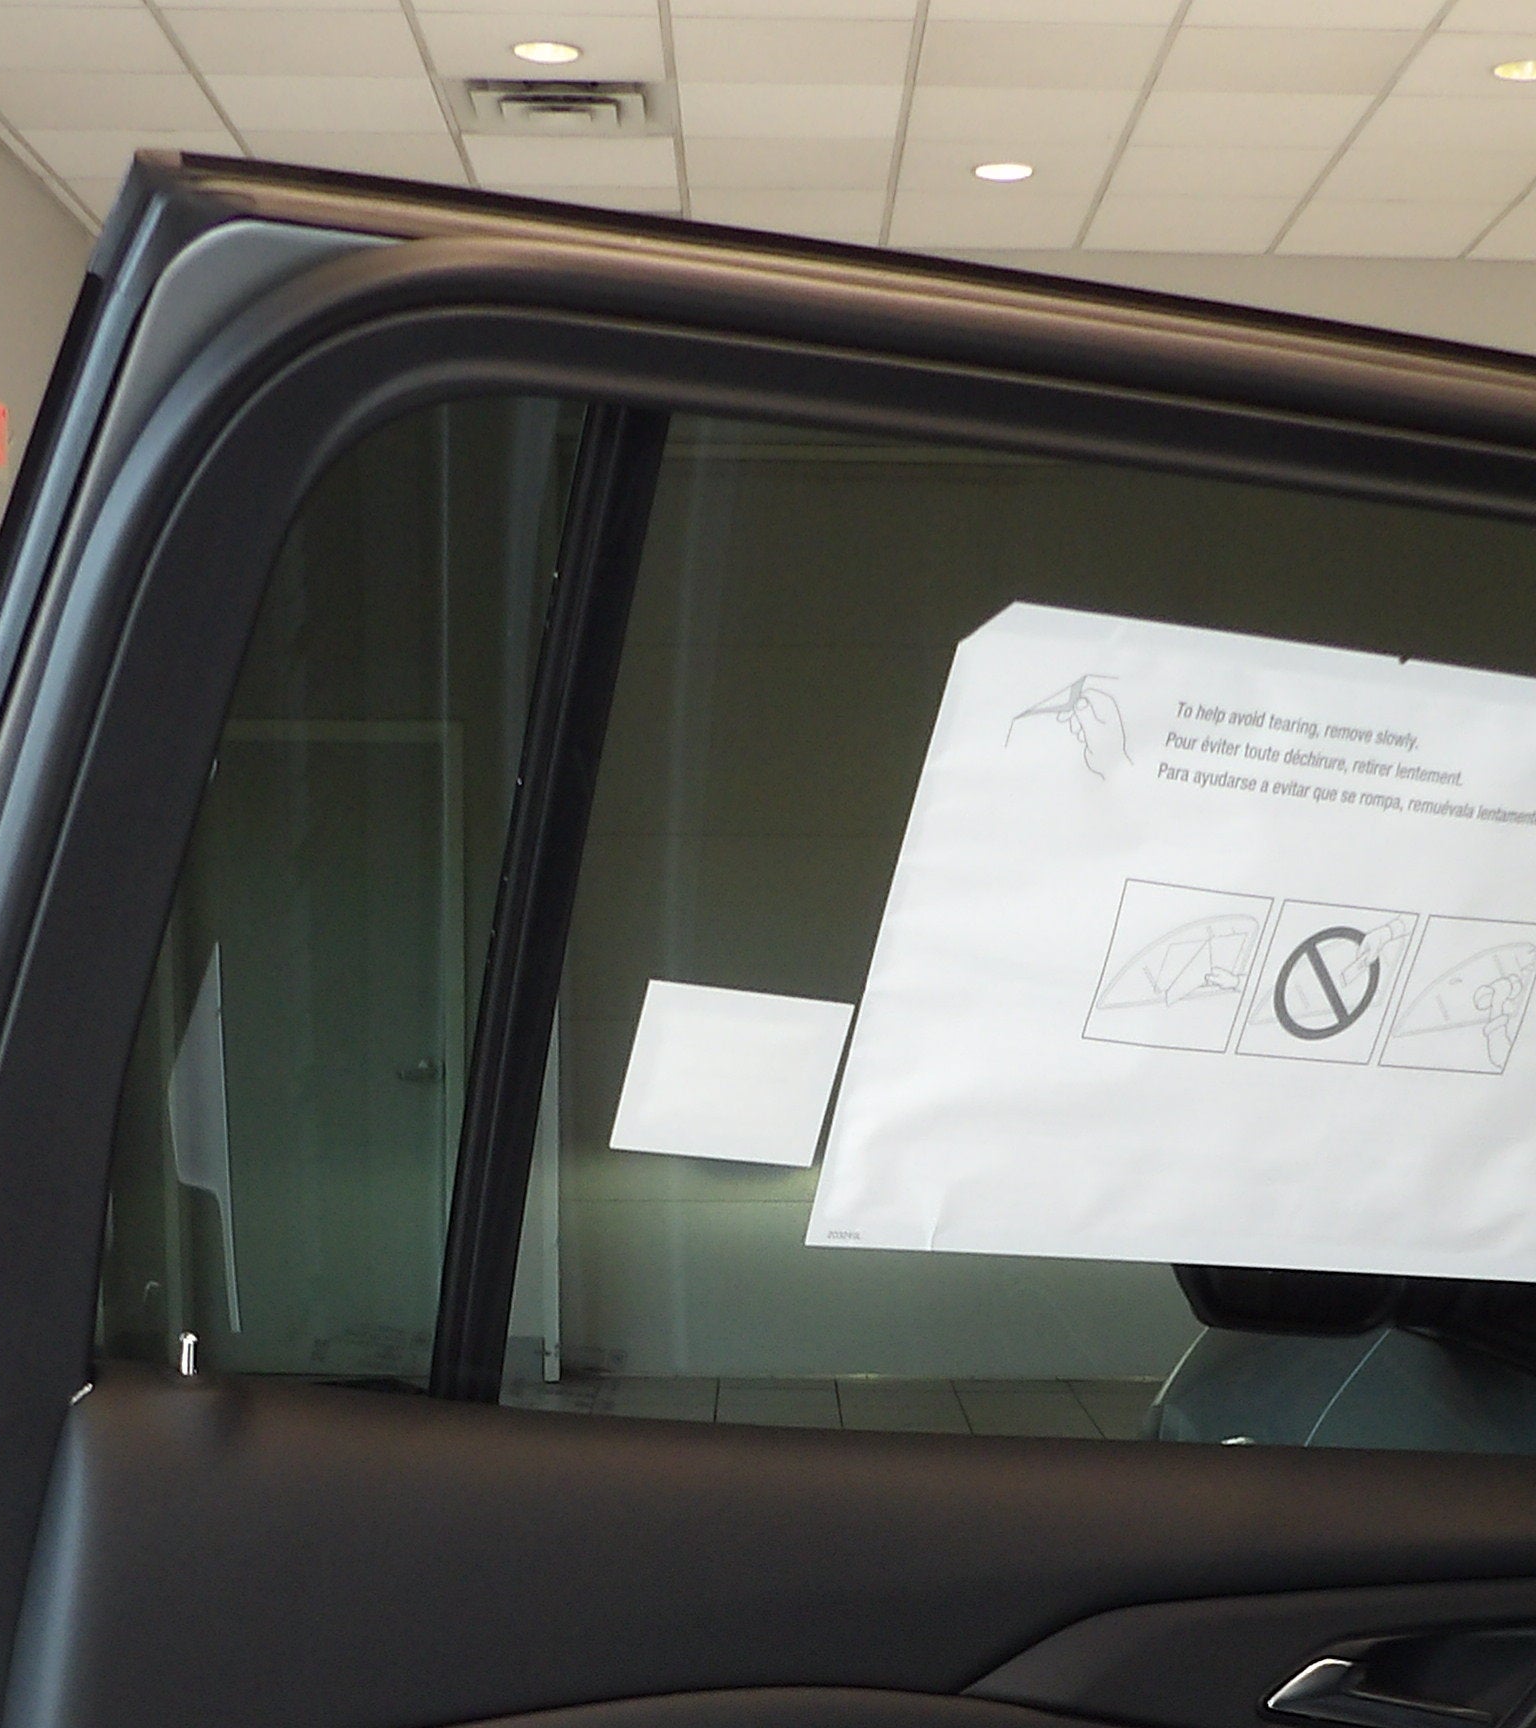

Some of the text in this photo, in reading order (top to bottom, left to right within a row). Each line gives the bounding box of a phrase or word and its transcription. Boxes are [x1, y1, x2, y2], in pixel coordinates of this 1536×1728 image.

[1177, 702, 1419, 752] To help avoid tearing, remove slowly.
[1165, 731, 1197, 750] Pour
[1201, 735, 1241, 757] éviter
[1244, 743, 1280, 763] toute
[1283, 749, 1348, 775] déchirure,
[1353, 758, 1394, 777] retirer
[1158, 762, 1189, 782] Para
[1193, 770, 1257, 792] ayudarse
[1260, 780, 1269, 793] a
[1272, 779, 1311, 798] evitar
[1313, 786, 1338, 803] que
[1341, 789, 1357, 804] se
[1359, 791, 1403, 813] rompa,
